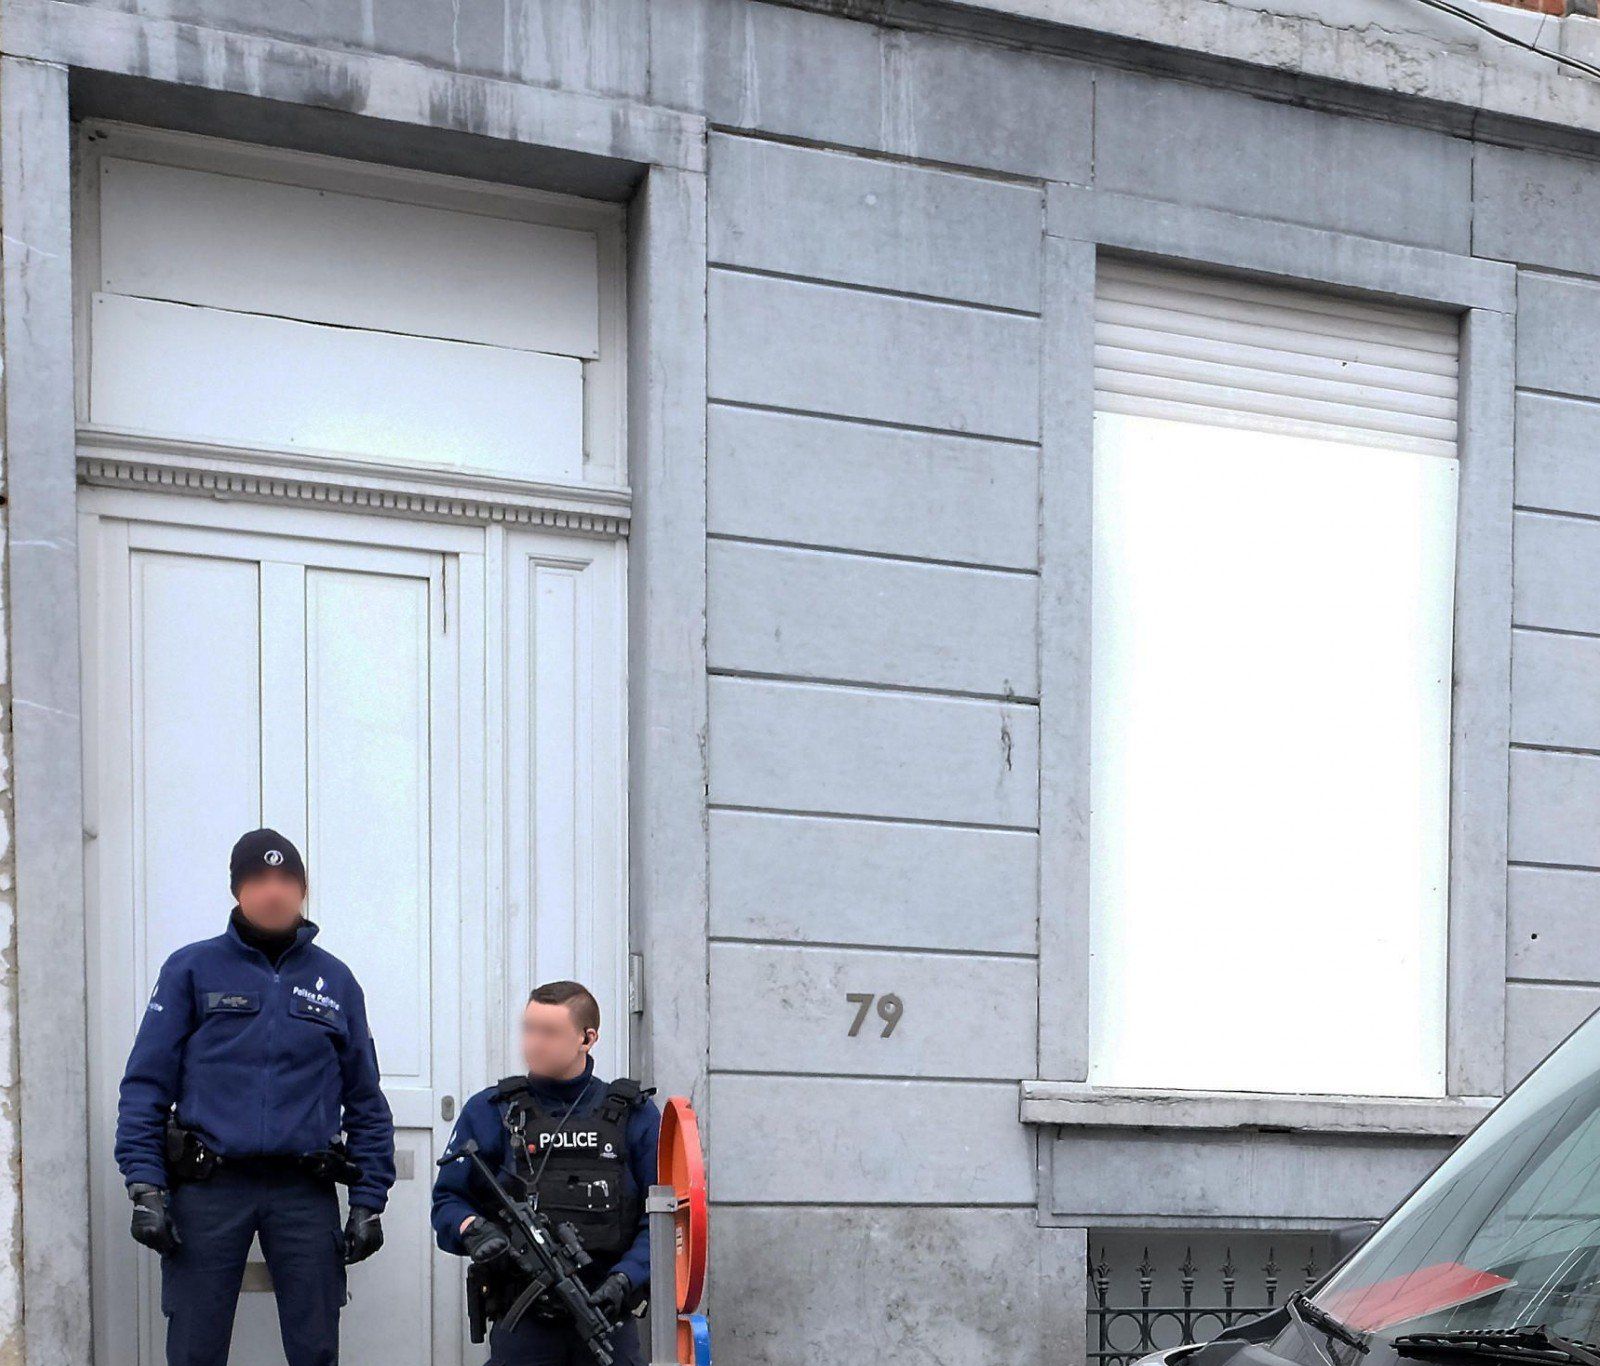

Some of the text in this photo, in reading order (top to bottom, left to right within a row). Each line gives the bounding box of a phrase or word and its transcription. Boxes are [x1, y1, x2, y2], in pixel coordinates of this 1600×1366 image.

[293, 986, 316, 1000] Police
[846, 992, 904, 1038] 79
[539, 1132, 598, 1149] POLICE
